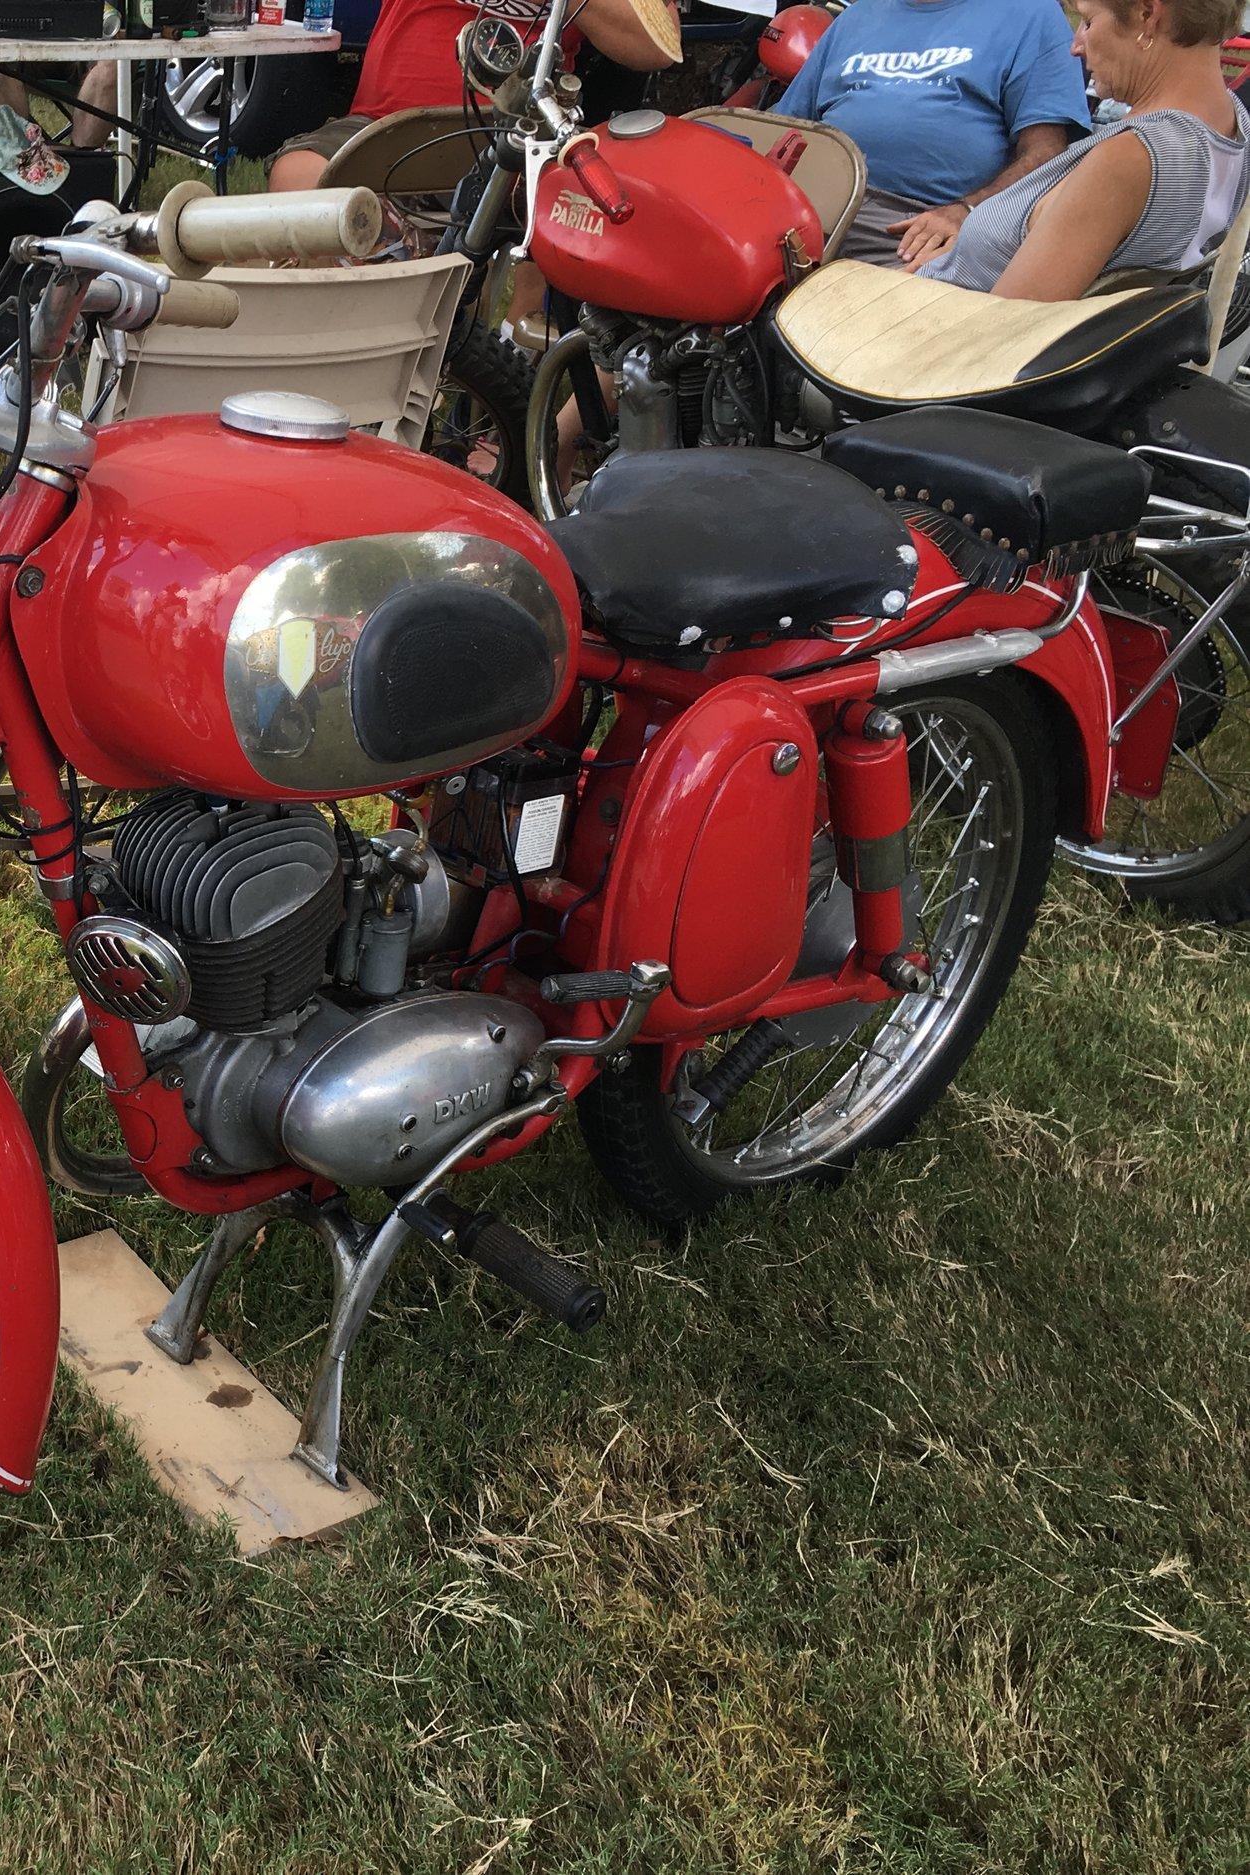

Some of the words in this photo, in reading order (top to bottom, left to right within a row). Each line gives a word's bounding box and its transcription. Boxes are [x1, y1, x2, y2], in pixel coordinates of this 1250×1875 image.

[841, 47, 973, 77] TRIUMPH
[549, 201, 604, 237] PARILLA
[319, 628, 352, 673] lujo
[434, 1083, 490, 1124] DKW
